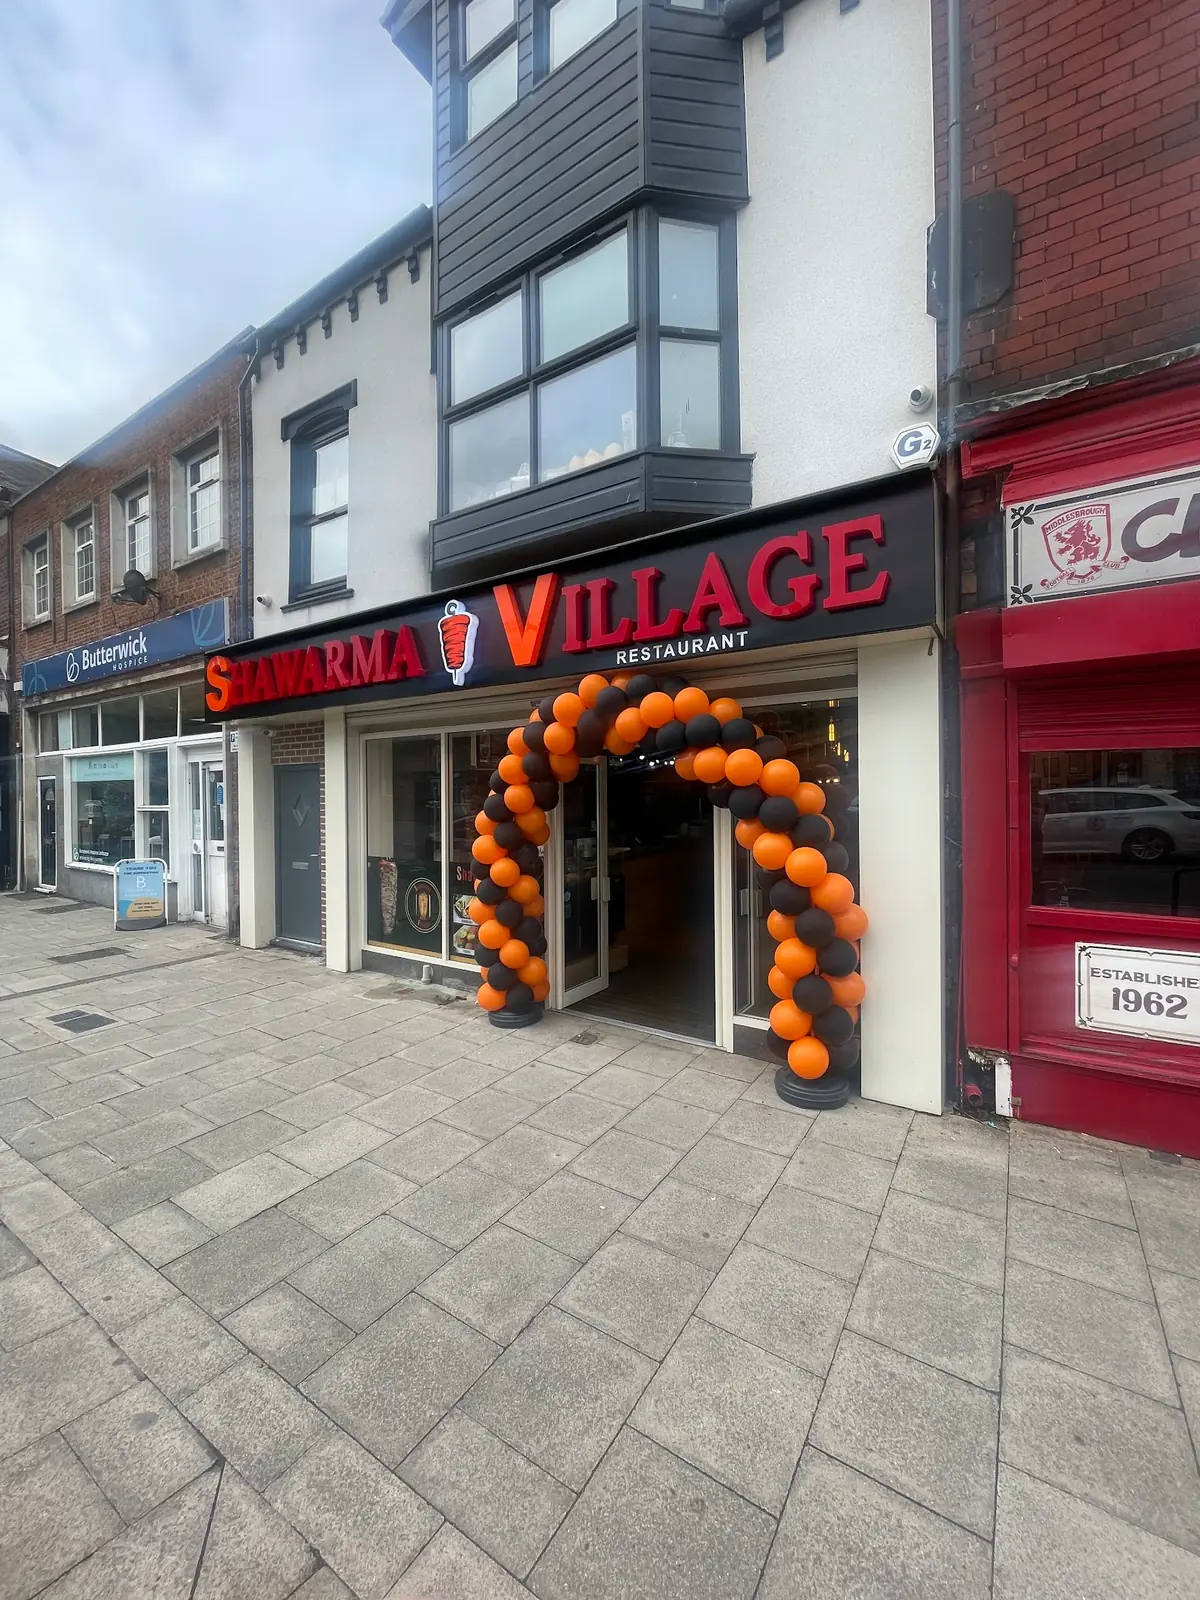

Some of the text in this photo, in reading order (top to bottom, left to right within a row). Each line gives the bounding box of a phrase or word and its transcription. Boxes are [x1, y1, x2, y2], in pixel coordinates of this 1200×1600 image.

[898, 431, 932, 457] G2
[1045, 507, 1106, 533] MIDDLESBROUGH
[1102, 561, 1120, 569] CLUB
[206, 514, 890, 712] SHAWARMA VILLAGE
[82, 631, 147, 670] Butterwick
[616, 631, 749, 665] RESTAURANT
[112, 655, 148, 671] HOSPICE
[457, 866, 474, 881] Sha
[1112, 987, 1188, 1020] 1962
